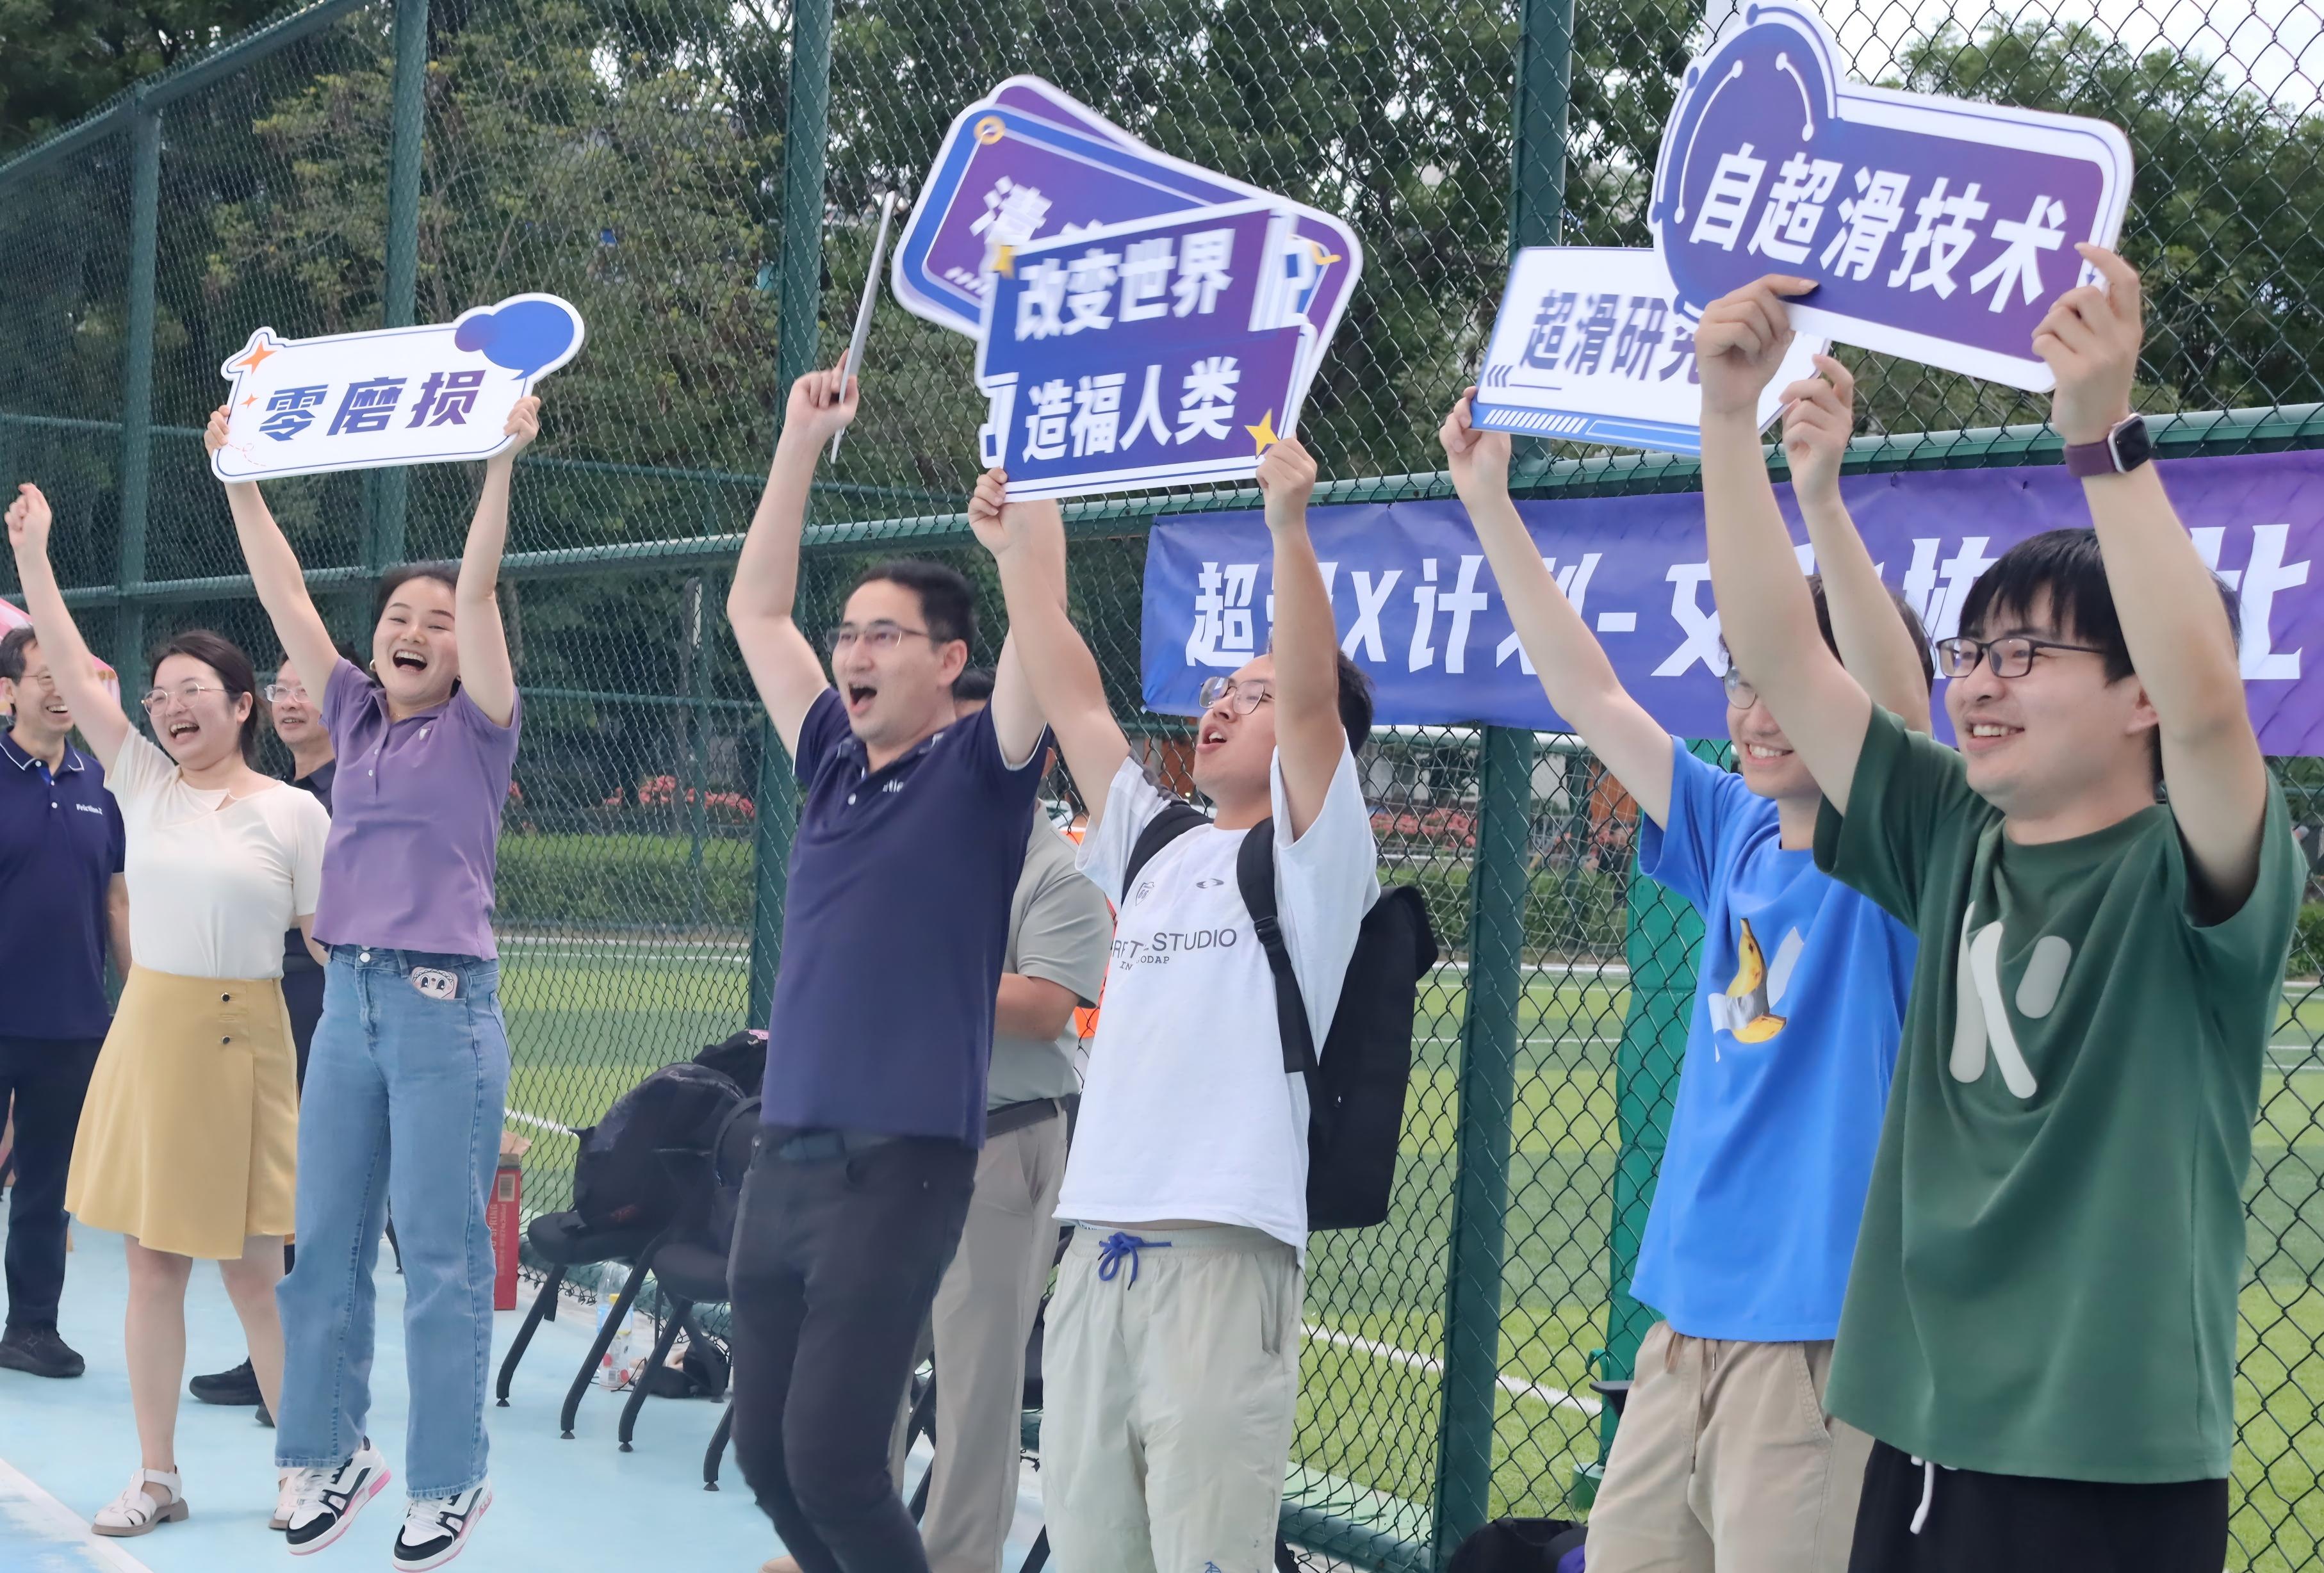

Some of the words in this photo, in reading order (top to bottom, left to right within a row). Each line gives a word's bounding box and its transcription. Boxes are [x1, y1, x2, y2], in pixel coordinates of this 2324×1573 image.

[1689, 142, 2067, 314] 自超滑技术
[1015, 228, 1236, 341] 改变世界
[259, 370, 486, 441] 零磨损
[1022, 356, 1241, 464] 造福人类
[1152, 929, 1237, 952] STUDIO
